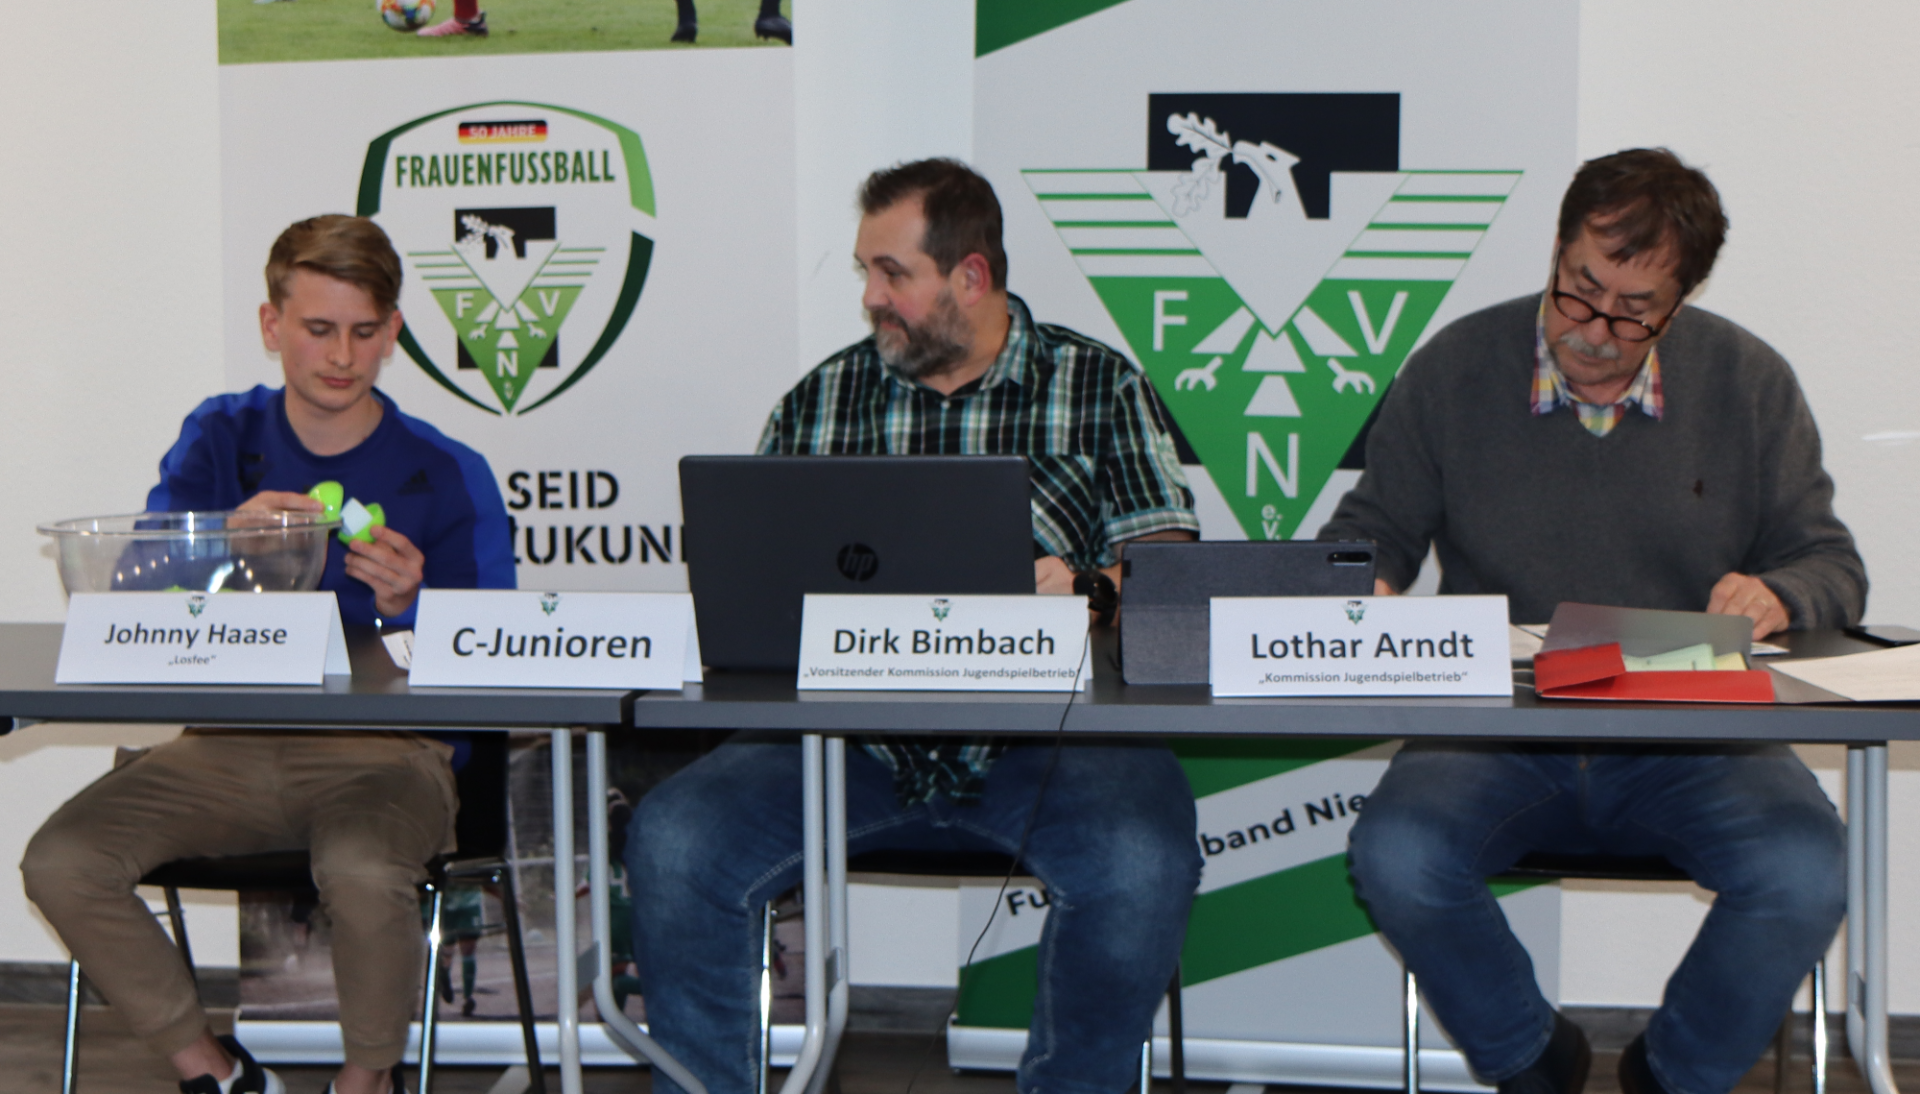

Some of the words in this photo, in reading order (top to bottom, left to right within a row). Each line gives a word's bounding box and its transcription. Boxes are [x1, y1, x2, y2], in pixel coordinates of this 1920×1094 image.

[469, 126, 488, 140] 50
[491, 124, 537, 138] JAHRE
[396, 150, 615, 188] FRAUENFUSSBALL
[455, 292, 474, 319] F
[538, 290, 561, 317] V
[1153, 290, 1189, 352] F
[1347, 290, 1409, 354] V
[496, 351, 518, 377] N
[1246, 431, 1299, 498] N
[507, 471, 619, 510] SEID
[512, 525, 688, 565] UKUN
[843, 544, 874, 581] hp
[104, 622, 200, 650] Johnny
[207, 624, 288, 645] Haase
[452, 627, 652, 659] C-Junioren
[834, 628, 900, 655] Dirk
[912, 628, 1055, 655] Bimbach
[1251, 631, 1363, 659] Lothar
[1374, 631, 1474, 658] Arndt
[887, 667, 960, 678] Kommission
